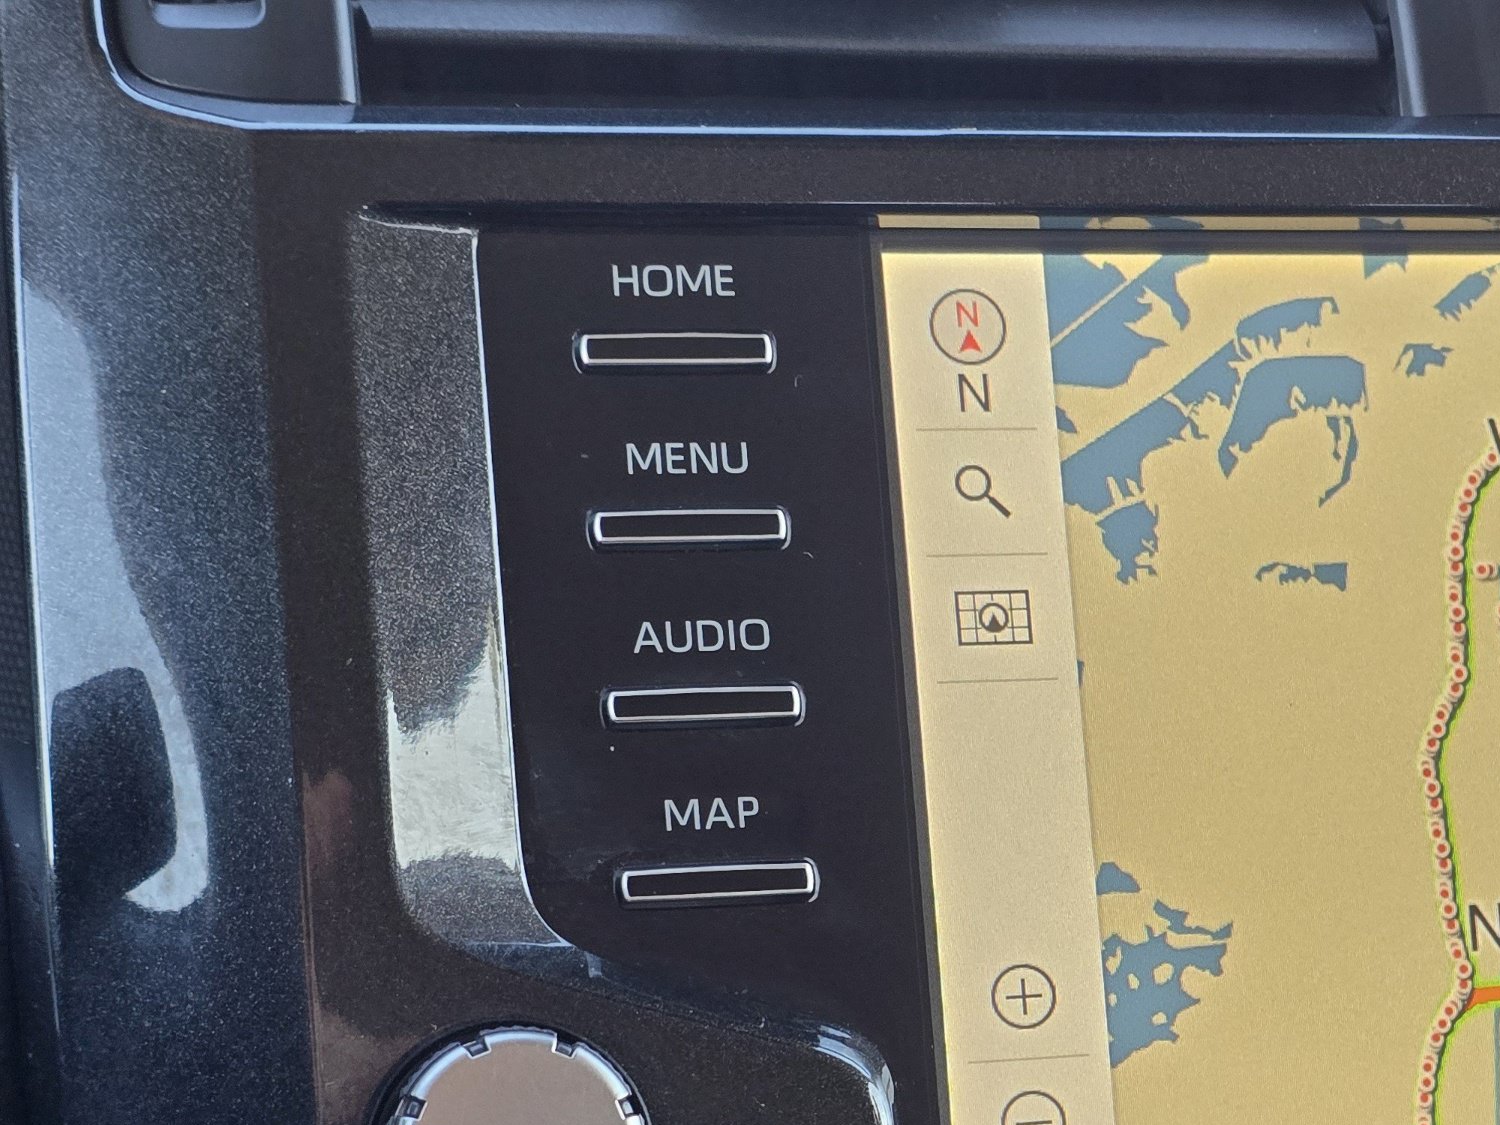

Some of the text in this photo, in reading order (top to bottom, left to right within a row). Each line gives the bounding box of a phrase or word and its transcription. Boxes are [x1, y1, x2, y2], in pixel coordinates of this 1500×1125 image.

[612, 264, 735, 297] HOME
[957, 373, 991, 413] N
[626, 441, 749, 475] MENU
[633, 618, 771, 654] AUDIO
[664, 796, 760, 832] MAP
